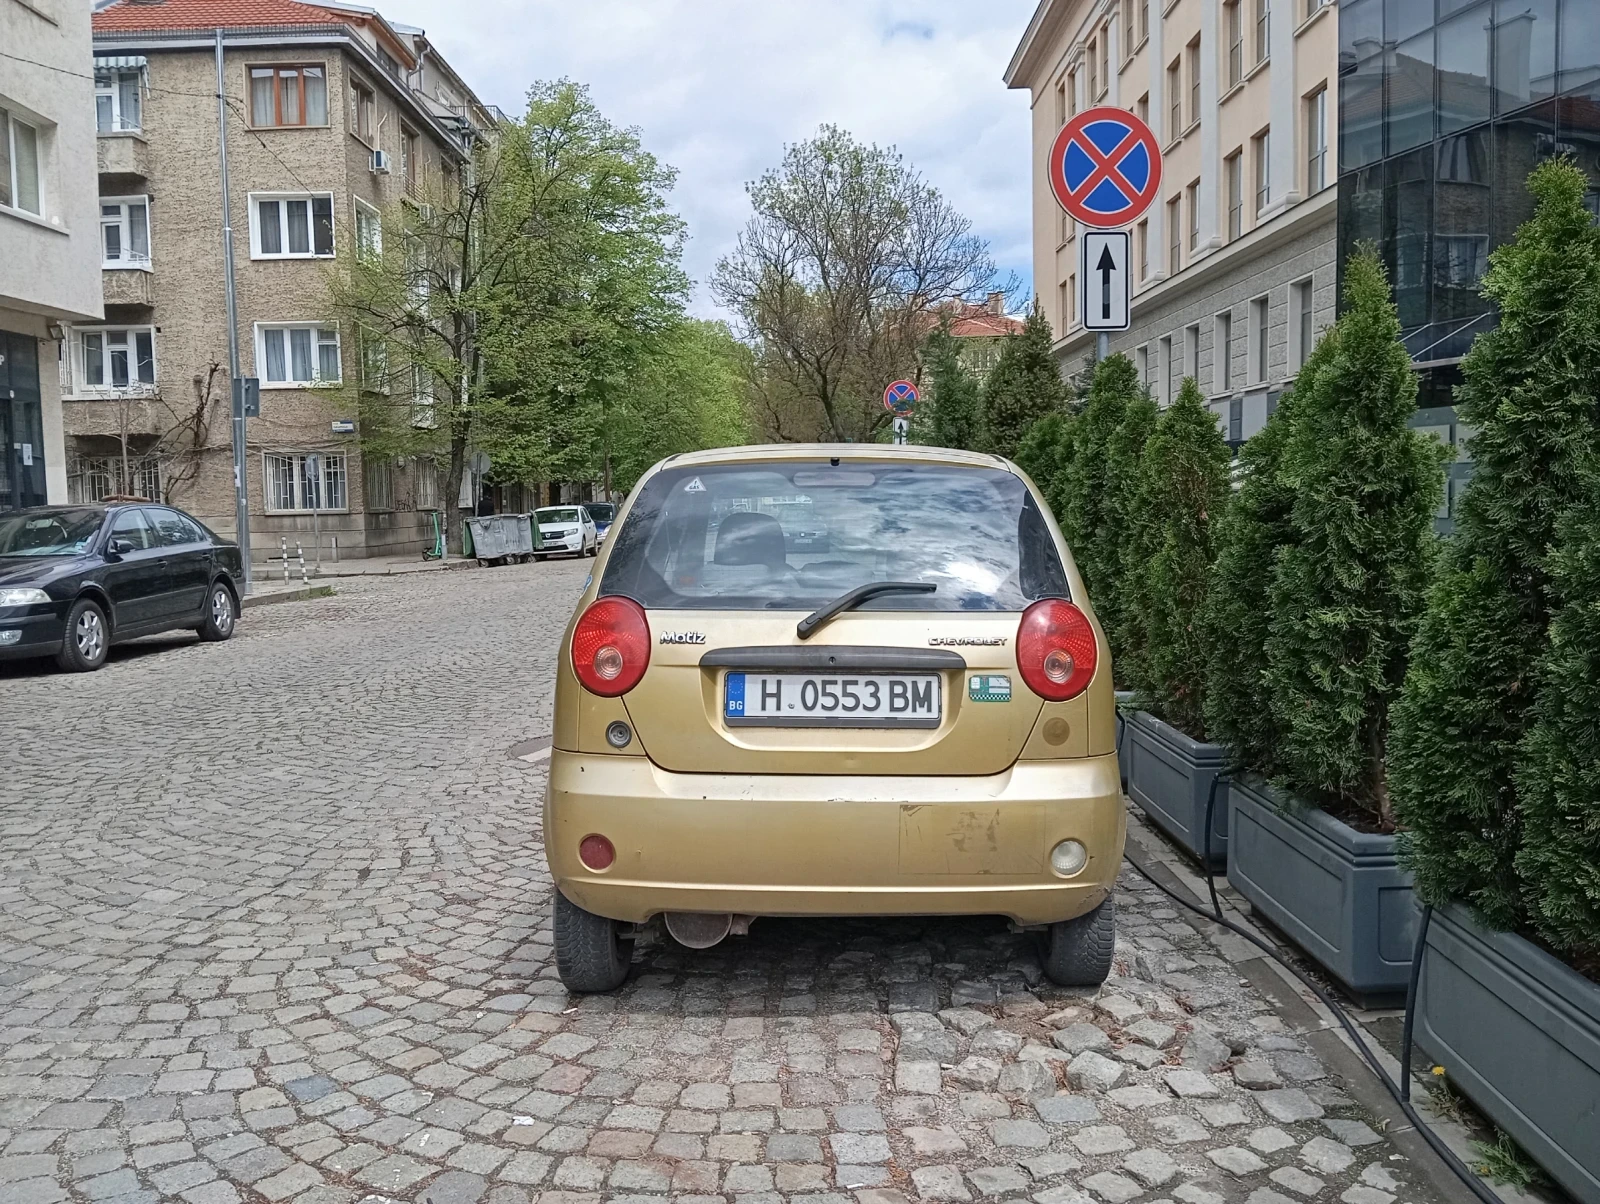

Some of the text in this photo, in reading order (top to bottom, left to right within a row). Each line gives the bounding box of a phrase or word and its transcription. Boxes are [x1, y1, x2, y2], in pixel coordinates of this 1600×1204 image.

[659, 630, 706, 645] Matiz
[928, 636, 1008, 647] CHEVROLET
[760, 679, 782, 712] H
[800, 679, 881, 712] 0553
[888, 680, 933, 713] BM
[729, 701, 743, 710] BG
